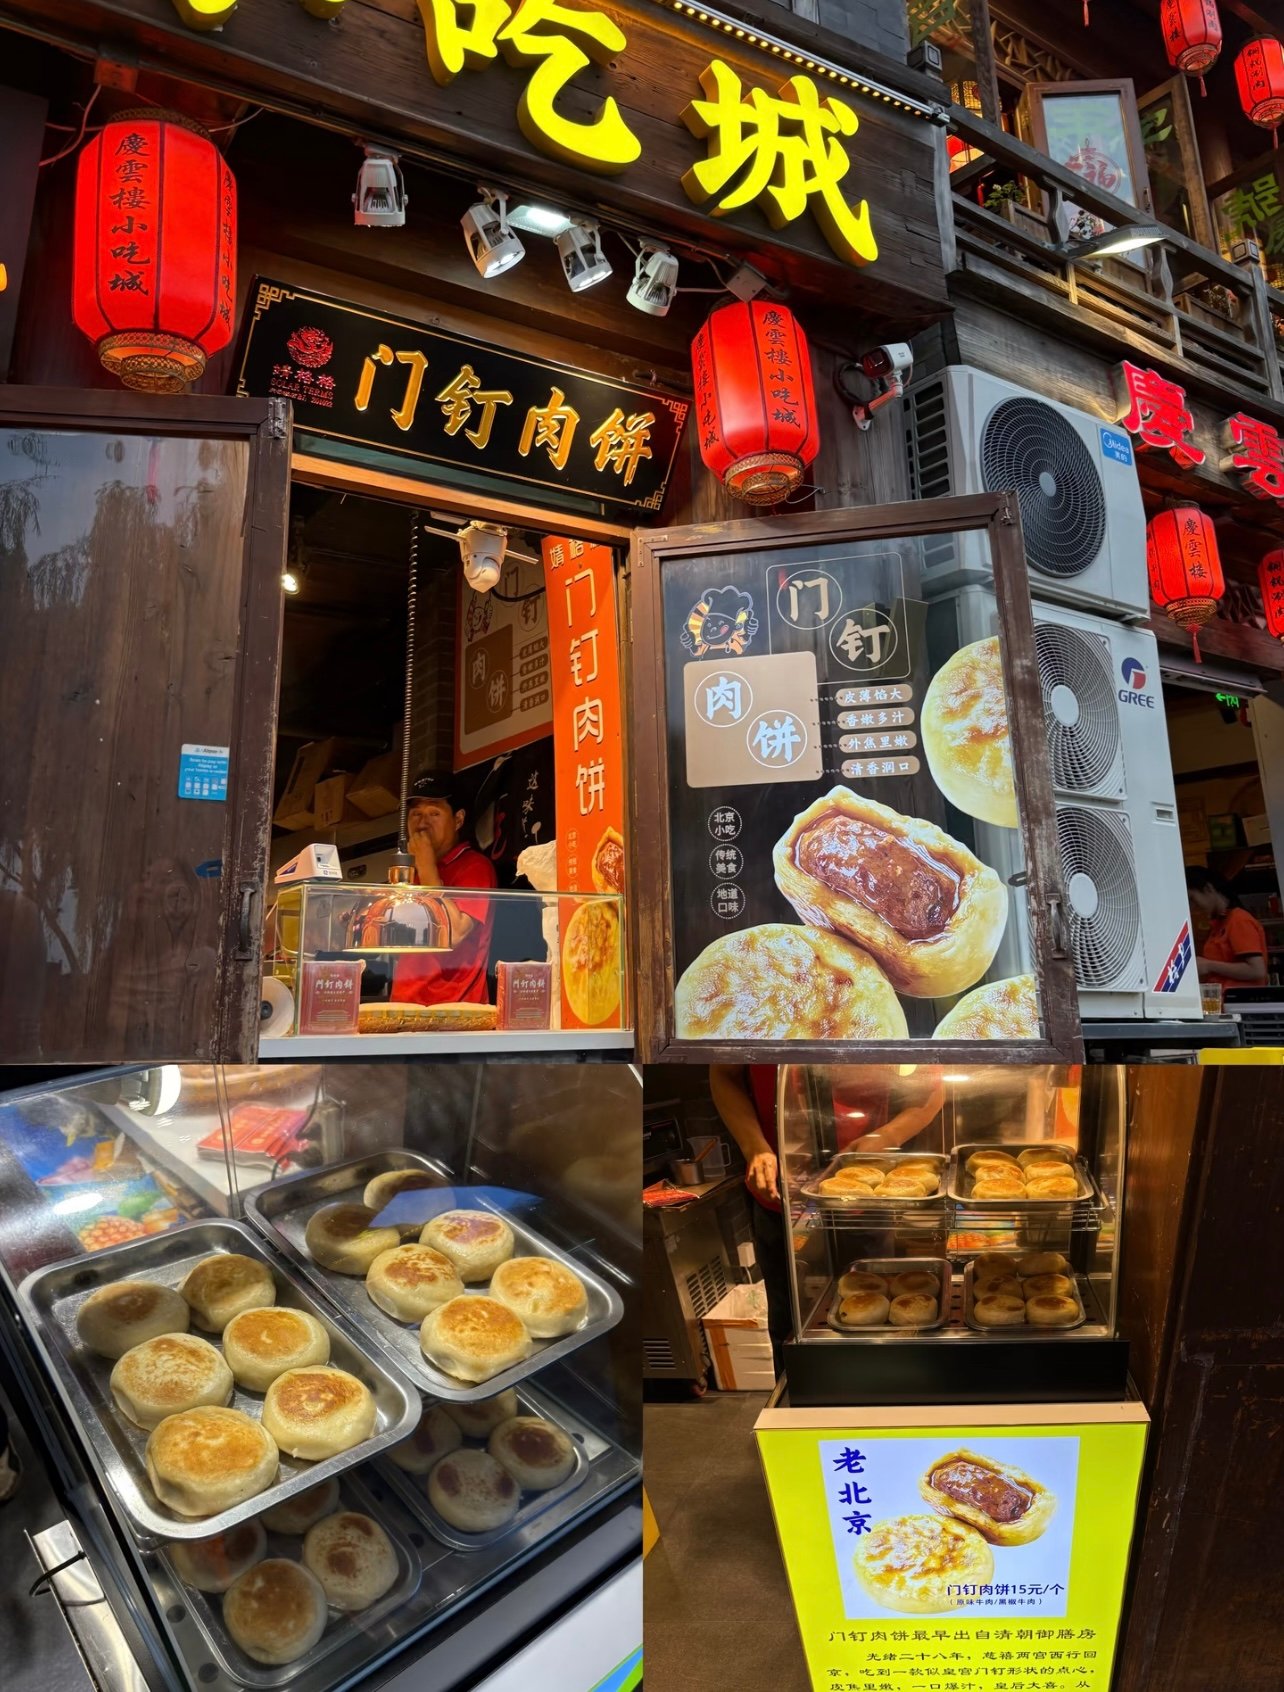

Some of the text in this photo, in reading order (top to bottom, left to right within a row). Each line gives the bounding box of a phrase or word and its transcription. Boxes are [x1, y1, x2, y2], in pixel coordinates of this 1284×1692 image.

[108, 132, 151, 297] 慶雲樓小吃城
[763, 310, 801, 429] 慶雲樓小吃城
[354, 343, 656, 487] 门钉肉饼
[550, 538, 600, 571] 婧格
[788, 576, 890, 663] 门钉
[564, 567, 606, 817] 门钉肉饼
[844, 687, 903, 703] 皮薄馅大
[1118, 689, 1154, 709] GREE
[705, 676, 801, 763] 肉饼
[846, 710, 905, 727] 香嫩多汁
[848, 734, 909, 750] 外焦里嫩
[850, 761, 909, 776] 清香润口
[714, 811, 735, 823] 北京
[714, 824, 736, 836] 小吃
[715, 849, 737, 861] 传统
[716, 862, 737, 874] 美食
[717, 888, 738, 900] 地道
[717, 901, 739, 913] 口味
[832, 1446, 872, 1536] 老北京
[946, 1583, 1065, 1597] 门钉肉饼15元/个
[828, 1628, 1097, 1643] 门钉肉饼最早出自清朝御膳房
